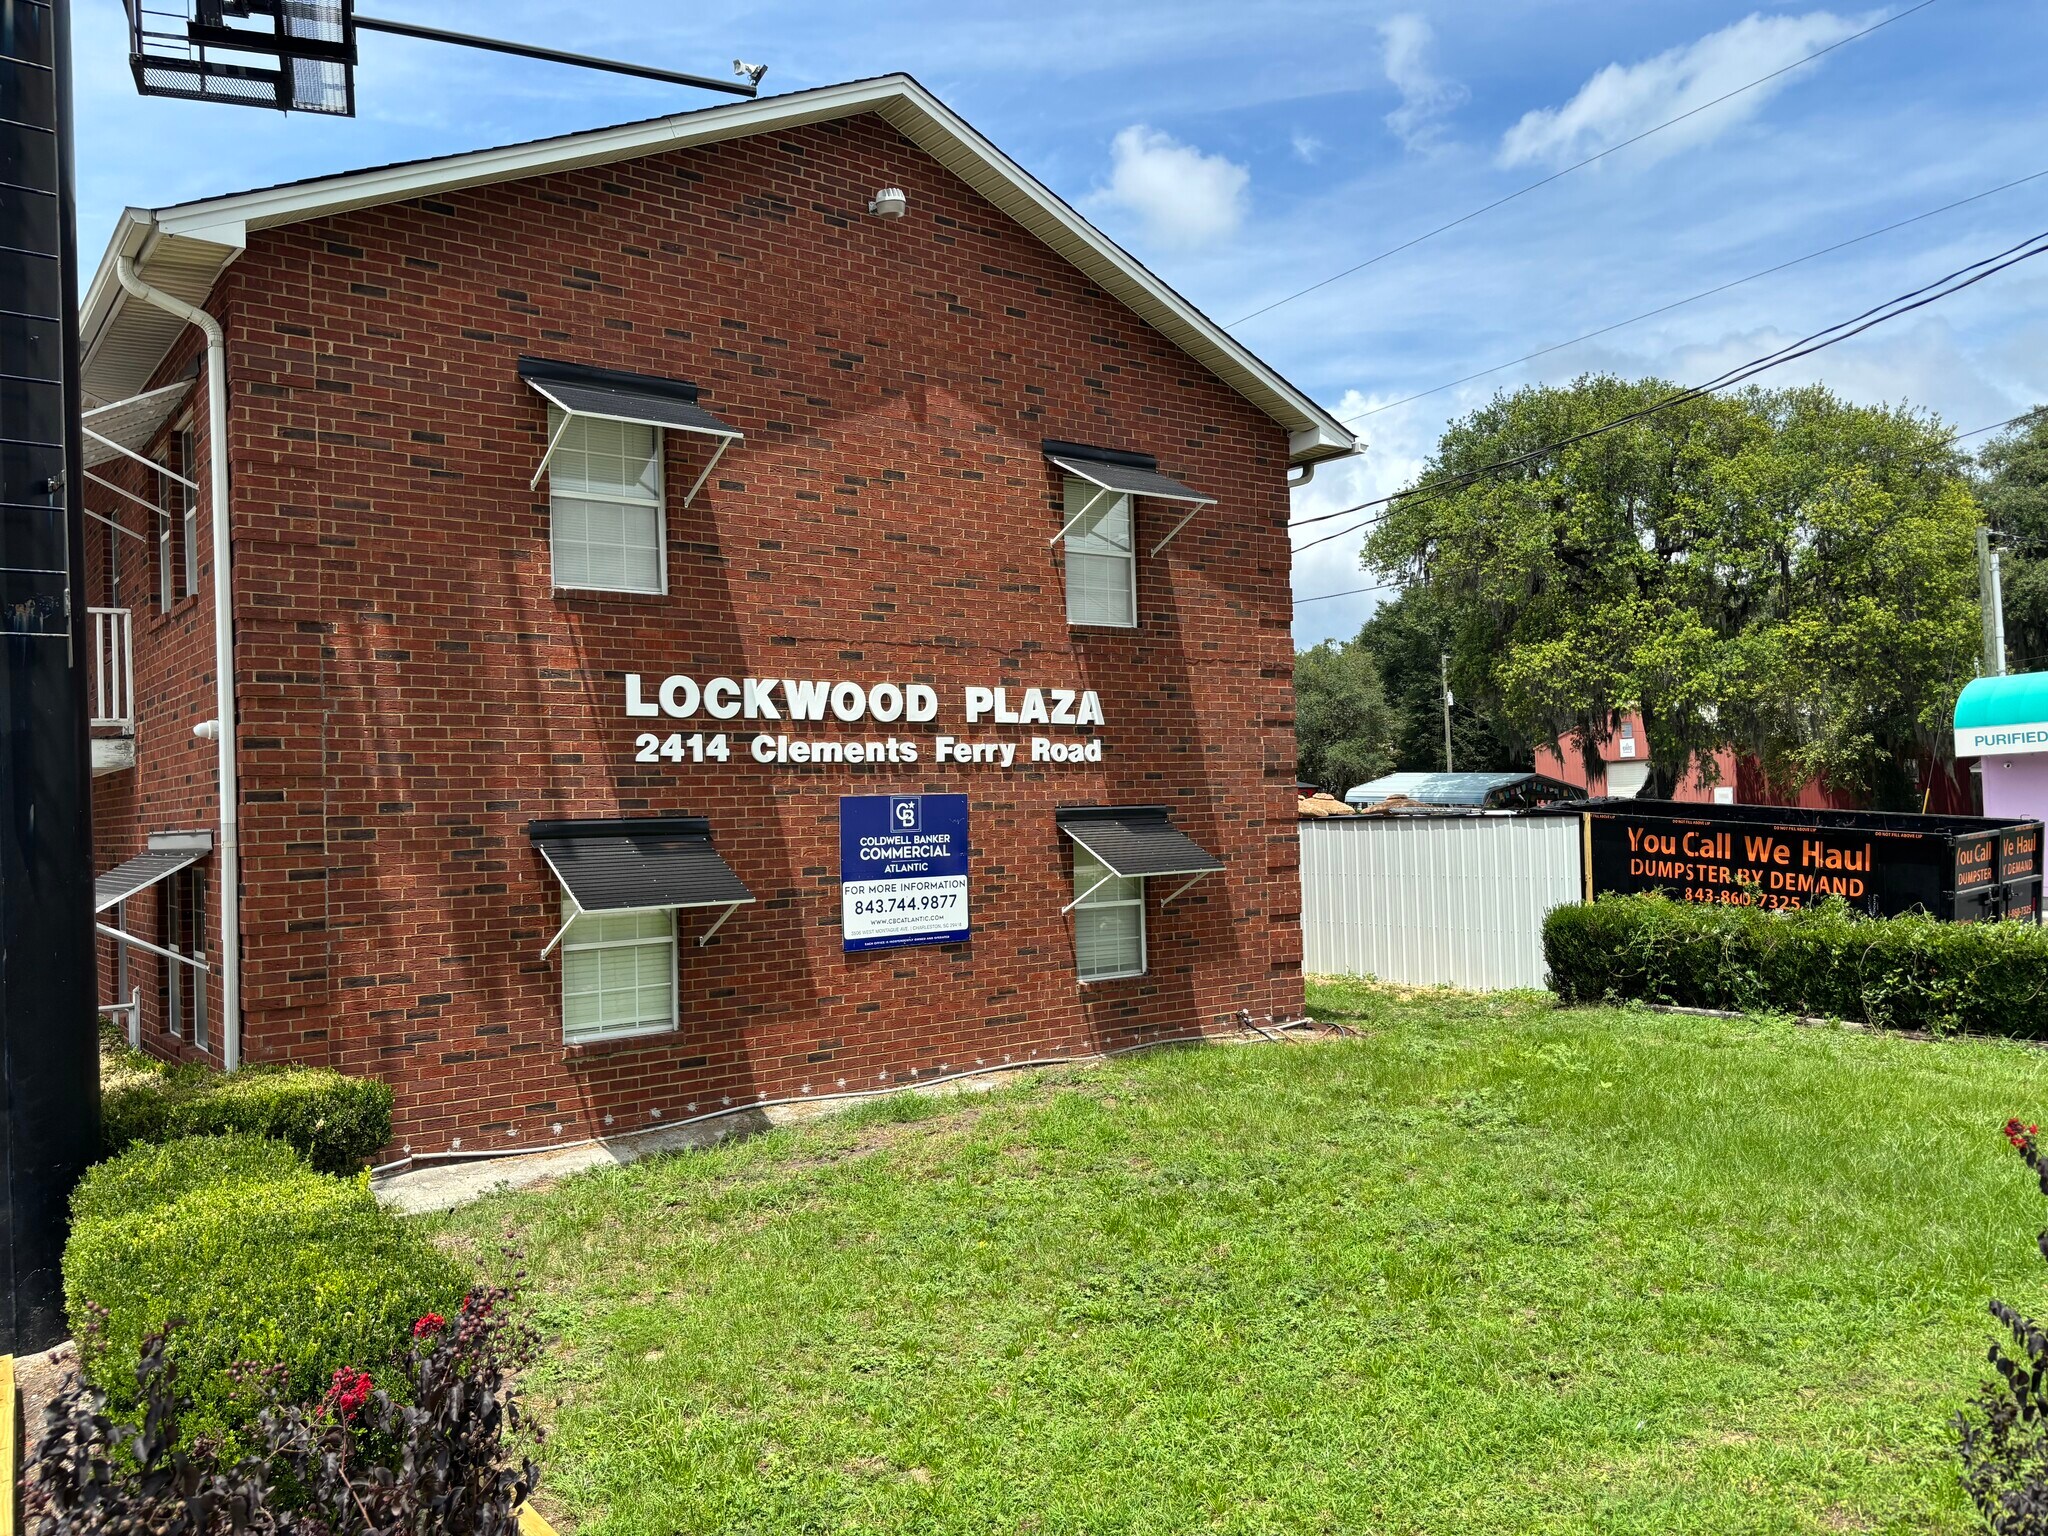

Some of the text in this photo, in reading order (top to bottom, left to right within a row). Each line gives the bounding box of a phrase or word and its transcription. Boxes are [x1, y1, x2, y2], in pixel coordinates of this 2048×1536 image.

[625, 673, 1106, 726] LOCKWOOD PLAZA
[1974, 730, 2048, 747] PURIFIED
[635, 733, 1102, 768] 2414 Clements Ferry Road
[859, 834, 951, 847] COLDWELL BANKER
[1628, 826, 1871, 872] You Call We Haul
[2016, 832, 2037, 854] Haul
[859, 844, 951, 861] COMMERCIAL
[1974, 841, 1992, 863] Call
[884, 862, 929, 874] ATLANTIC
[1958, 867, 1992, 886] DUMPSTER
[2007, 859, 2033, 875] DEMAND
[1630, 858, 1864, 897] DUMPSTER BY DEMAND
[844, 879, 966, 896] FOR MORE INFORMATION
[854, 894, 957, 915] 843.744.9877
[870, 914, 945, 926] WWW.CBCATLANTIC.COM
